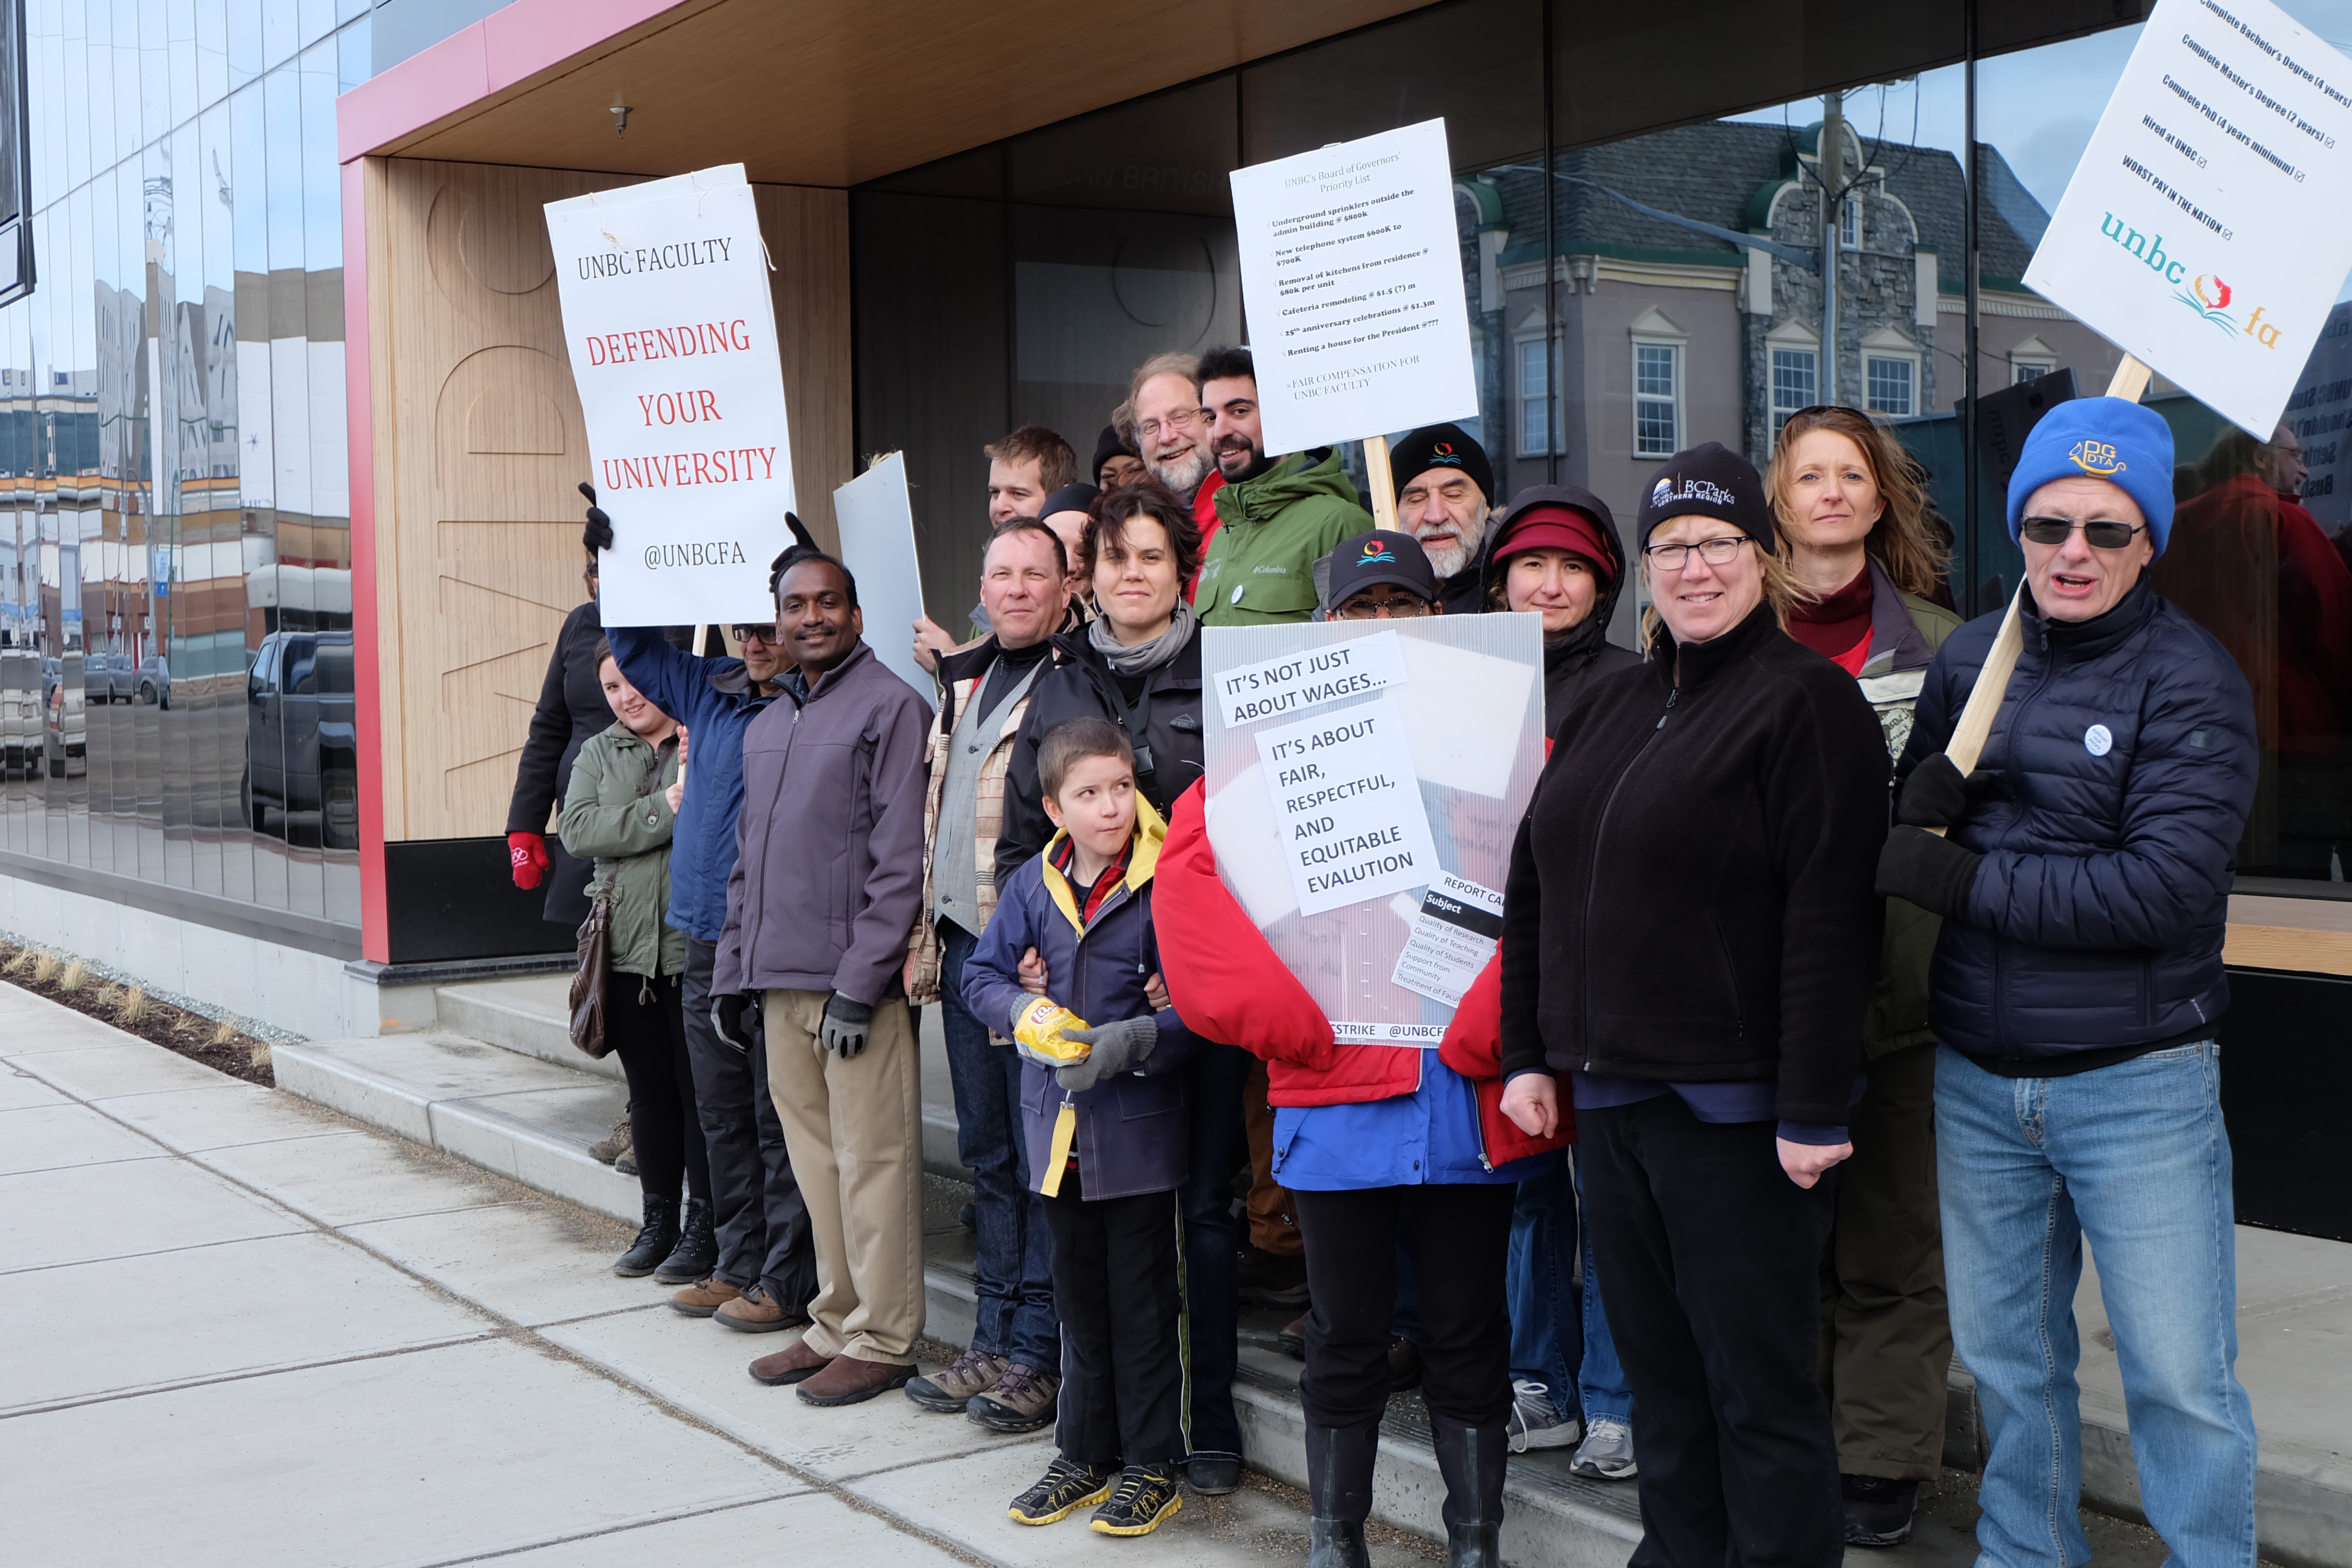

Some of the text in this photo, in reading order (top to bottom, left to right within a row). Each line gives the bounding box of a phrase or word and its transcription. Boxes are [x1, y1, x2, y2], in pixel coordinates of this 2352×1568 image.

[2240, 23, 2282, 61] Bachelor's
[2282, 55, 2314, 82] Degree
[2314, 77, 2325, 89] (4
[2324, 85, 2352, 108] years)
[2182, 34, 2325, 142] Complete Master's Degree (2 years)
[2142, 114, 2197, 161] Hired at UNBC
[2163, 74, 2295, 176] Complete PhD (4 years minimum)
[1284, 174, 1316, 188] UNBC's
[1318, 166, 1344, 180] Board
[1346, 163, 1355, 174] of
[1320, 174, 1371, 193] Priority List
[1272, 209, 1326, 227] Underground
[1328, 201, 1369, 216] sprinklers
[1371, 193, 1399, 205] outside
[2122, 156, 2223, 234] WORST PAY IN THE NATION
[1273, 227, 1298, 237] admin
[1299, 219, 1335, 231] building
[1275, 248, 1293, 257] New
[1295, 240, 1335, 253] telephone
[1337, 233, 1365, 245] system
[1367, 225, 1392, 237] $600K
[577, 237, 731, 280] UNBC FACULTY
[1276, 255, 1301, 267] $700K
[1278, 273, 1313, 286] Removal
[1325, 265, 1360, 277] kitchens
[1362, 260, 1382, 269] from
[1384, 251, 1421, 264] residence
[1301, 284, 1315, 293] per
[1317, 280, 1335, 288] unit
[2101, 211, 2282, 350] unbc fa
[1282, 304, 1319, 316] Cafeteria
[1321, 294, 1367, 308] remodeling
[1376, 288, 1393, 297] $1.5
[1395, 284, 1406, 294] (?)
[1285, 327, 1300, 336] 25th
[1302, 318, 1351, 332] anniversary
[1353, 307, 1401, 323] celebrations
[1411, 300, 1435, 310] $1.3m
[586, 319, 750, 366] DEFENDING
[1287, 345, 1320, 356] Renting
[1327, 340, 1351, 348] house
[1382, 324, 1420, 337] President
[1421, 318, 1439, 328] @???
[1292, 355, 1420, 388] FAIR COMPENSATION FOR
[1295, 379, 1369, 400] UNBC FACULTY
[637, 390, 723, 426] YOUR
[2083, 440, 2116, 464] PG
[2087, 453, 2113, 467] DTA
[602, 447, 775, 490] UNIVERSITY
[1658, 493, 1692, 508] NORTHERN
[645, 541, 746, 570] @UNBCFA
[1258, 565, 1286, 574] Columbia
[1226, 649, 1350, 695] IT'S NOT JUST
[1235, 673, 1386, 722] ABOUT WAGES...
[1272, 718, 1374, 761] IT'S ABOUT
[1279, 763, 1325, 787] FAIR,
[1286, 774, 1395, 814] RESPECTFUL,
[1295, 817, 1334, 841] AND
[1300, 826, 1402, 867] EQUITABLE
[1308, 851, 1413, 893] EVALUTION
[1426, 894, 1462, 914] Subject
[1444, 877, 1505, 907] REPORT CA
[1415, 927, 1439, 942] Quality
[1450, 940, 1479, 957] Teaching
[1419, 916, 1444, 931] Quality
[1453, 928, 1484, 945] Research
[1405, 951, 1450, 973] Support from
[1410, 940, 1435, 954] Quality
[1444, 952, 1474, 968] Students
[1402, 961, 1441, 982] Community
[1397, 973, 1433, 992] Treatment
[1442, 990, 1461, 1004] Facul
[1053, 1016, 1068, 1026] Class
